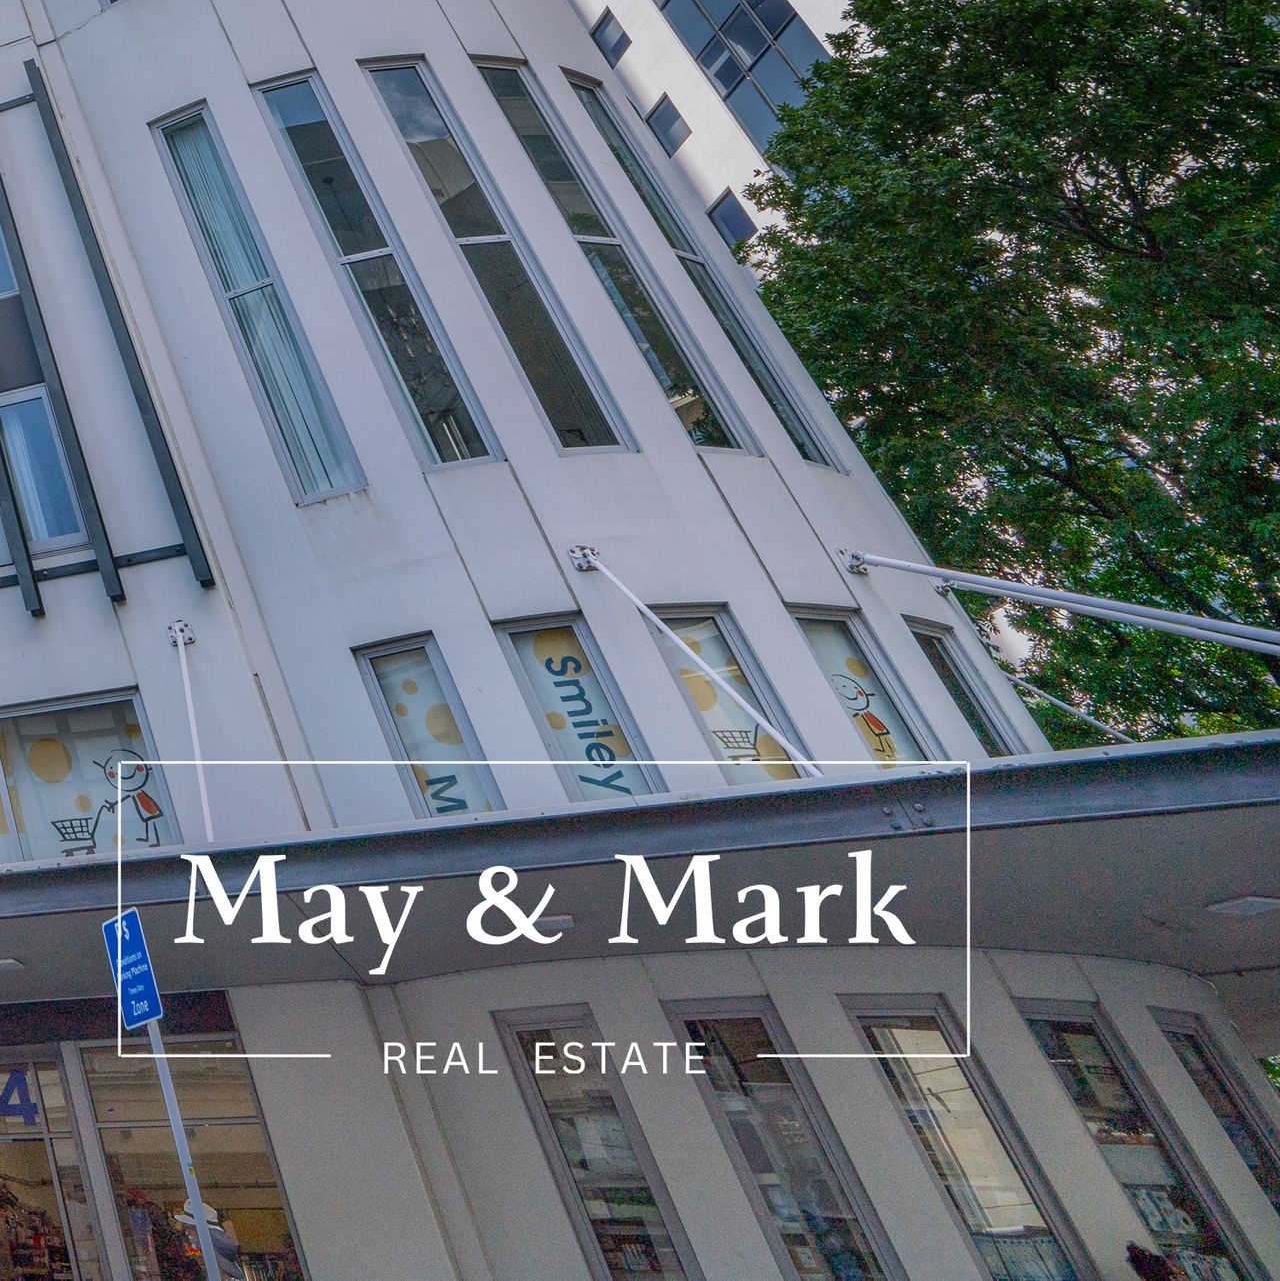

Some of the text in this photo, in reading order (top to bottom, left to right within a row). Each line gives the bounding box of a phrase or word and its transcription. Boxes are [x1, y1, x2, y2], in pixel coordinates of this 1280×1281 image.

[544, 655, 633, 796] Smiley
[116, 953, 137, 968] Cnditions
[131, 1000, 149, 1016] Zone
